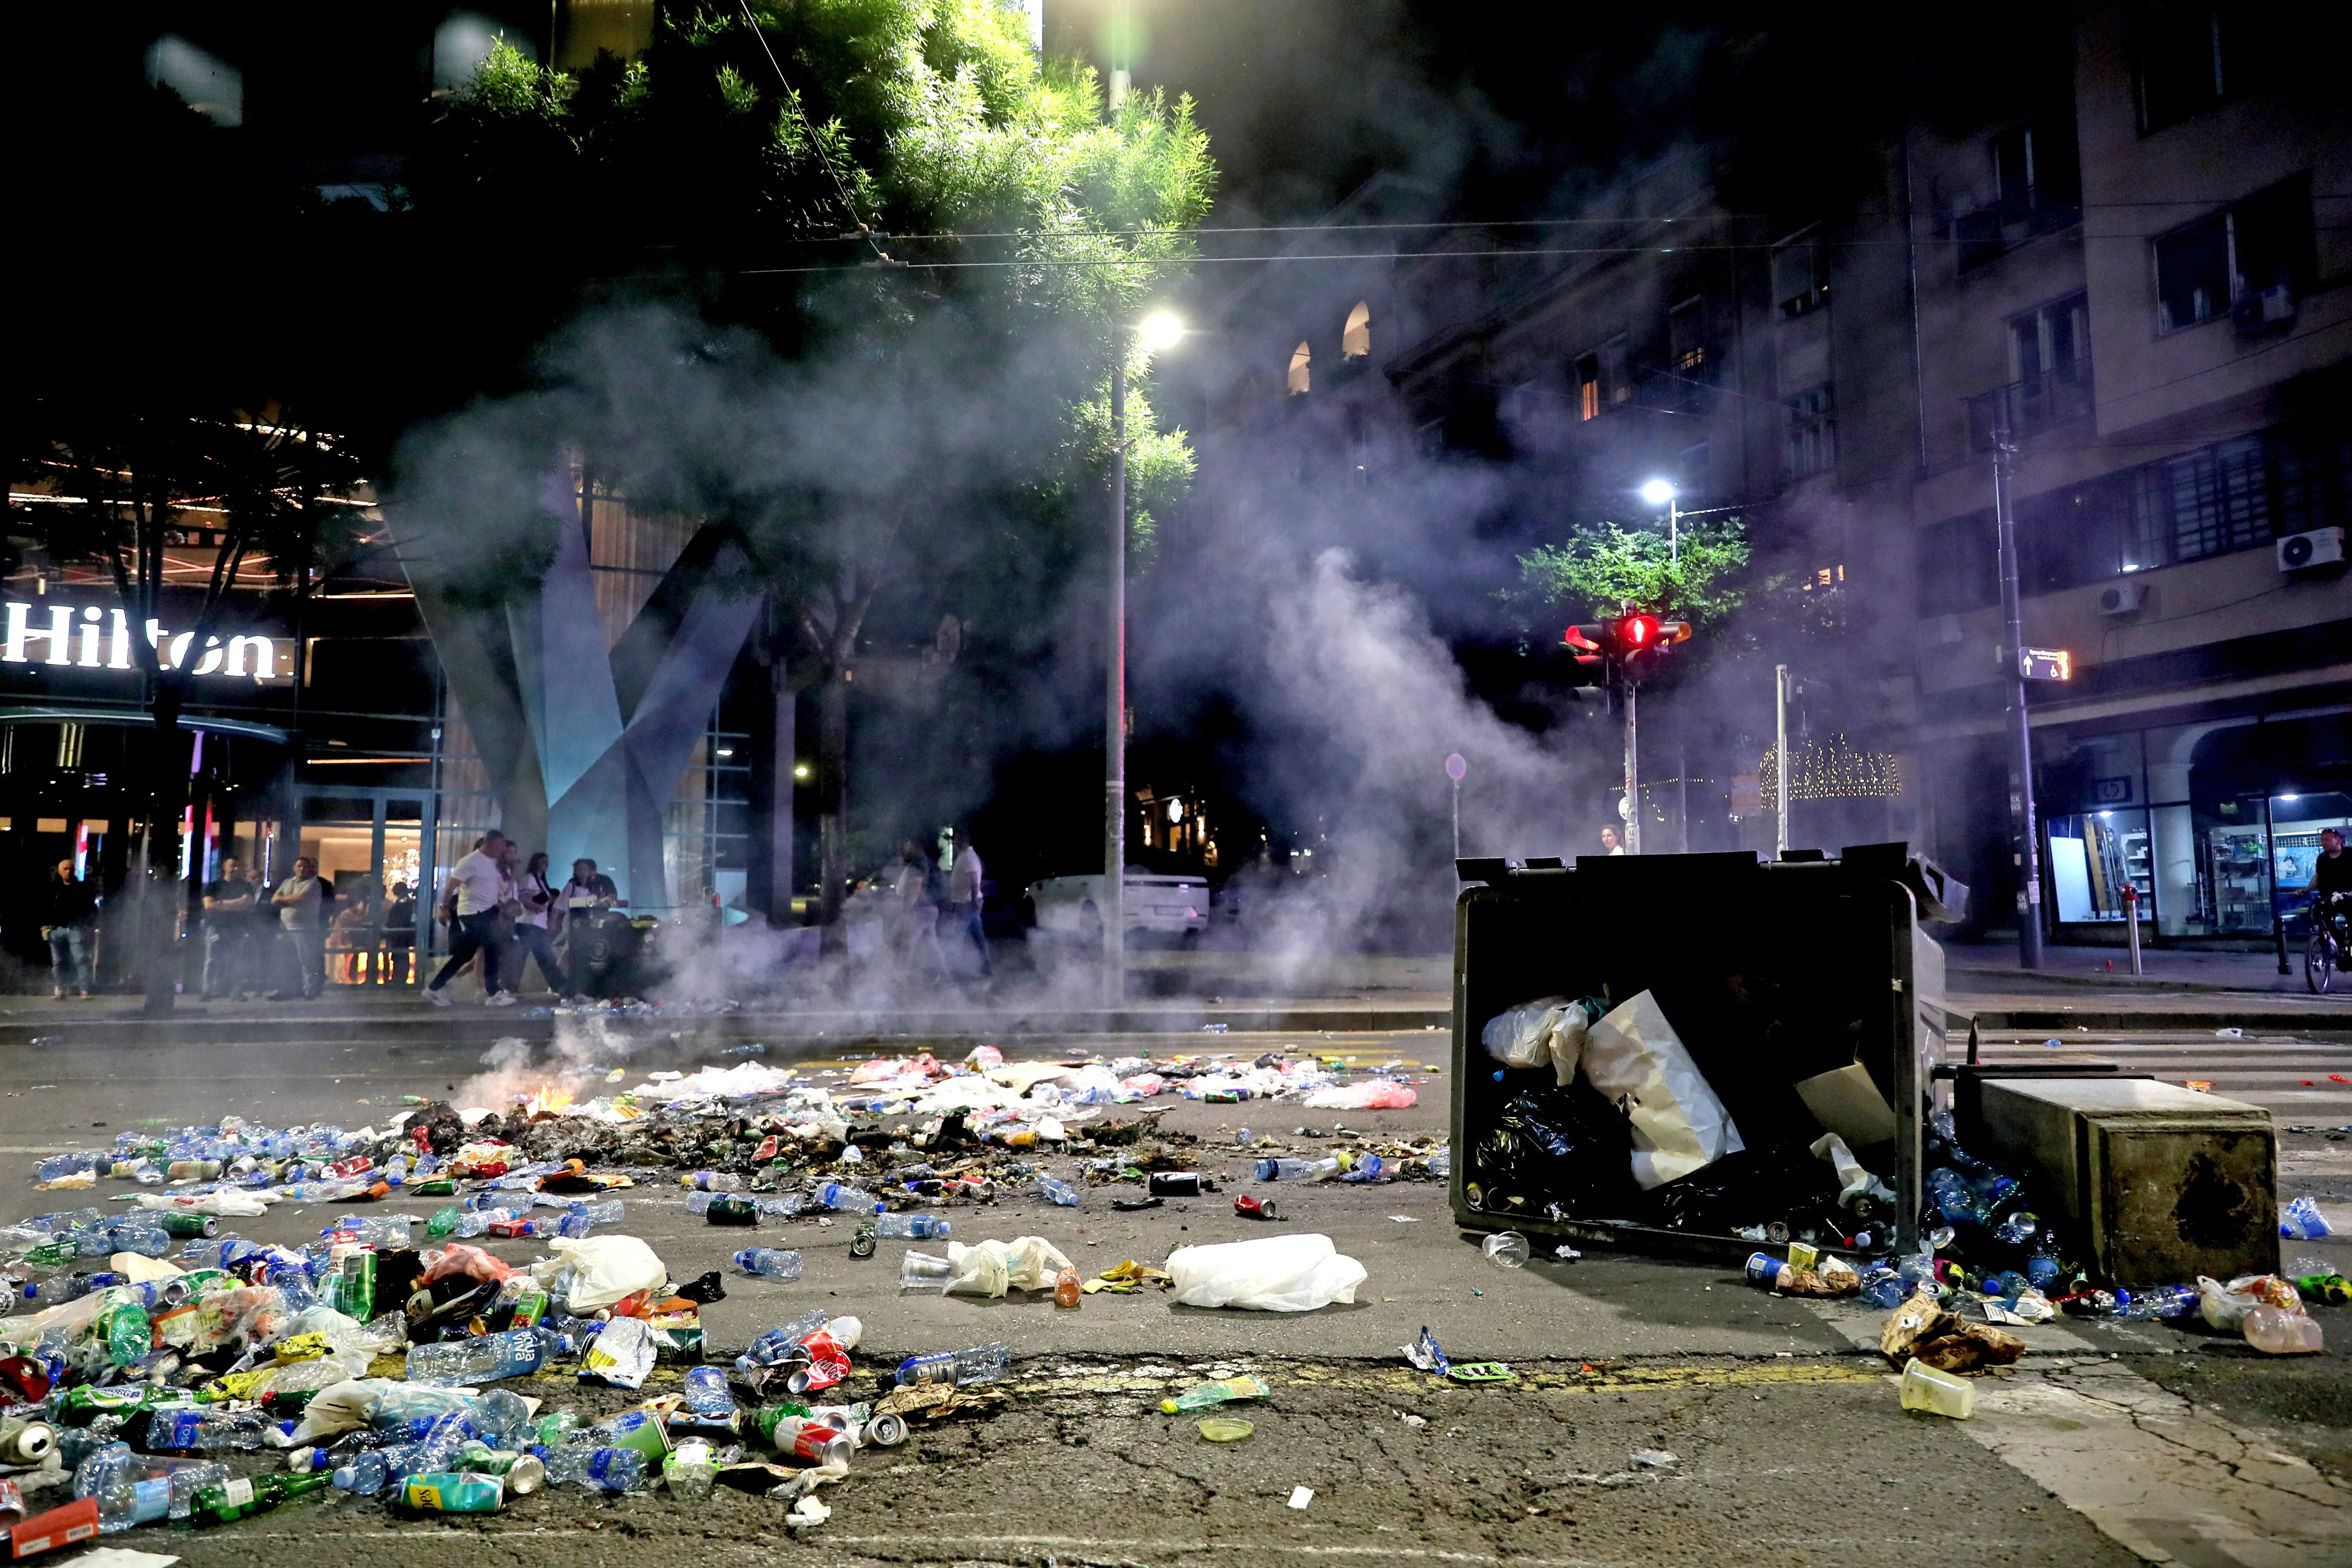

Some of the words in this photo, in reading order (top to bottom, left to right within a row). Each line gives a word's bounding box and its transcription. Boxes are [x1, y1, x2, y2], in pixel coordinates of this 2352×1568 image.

[512, 1333, 525, 1362] viva
[521, 1331, 535, 1362] aqua
[179, 1424, 192, 1446] rosa
